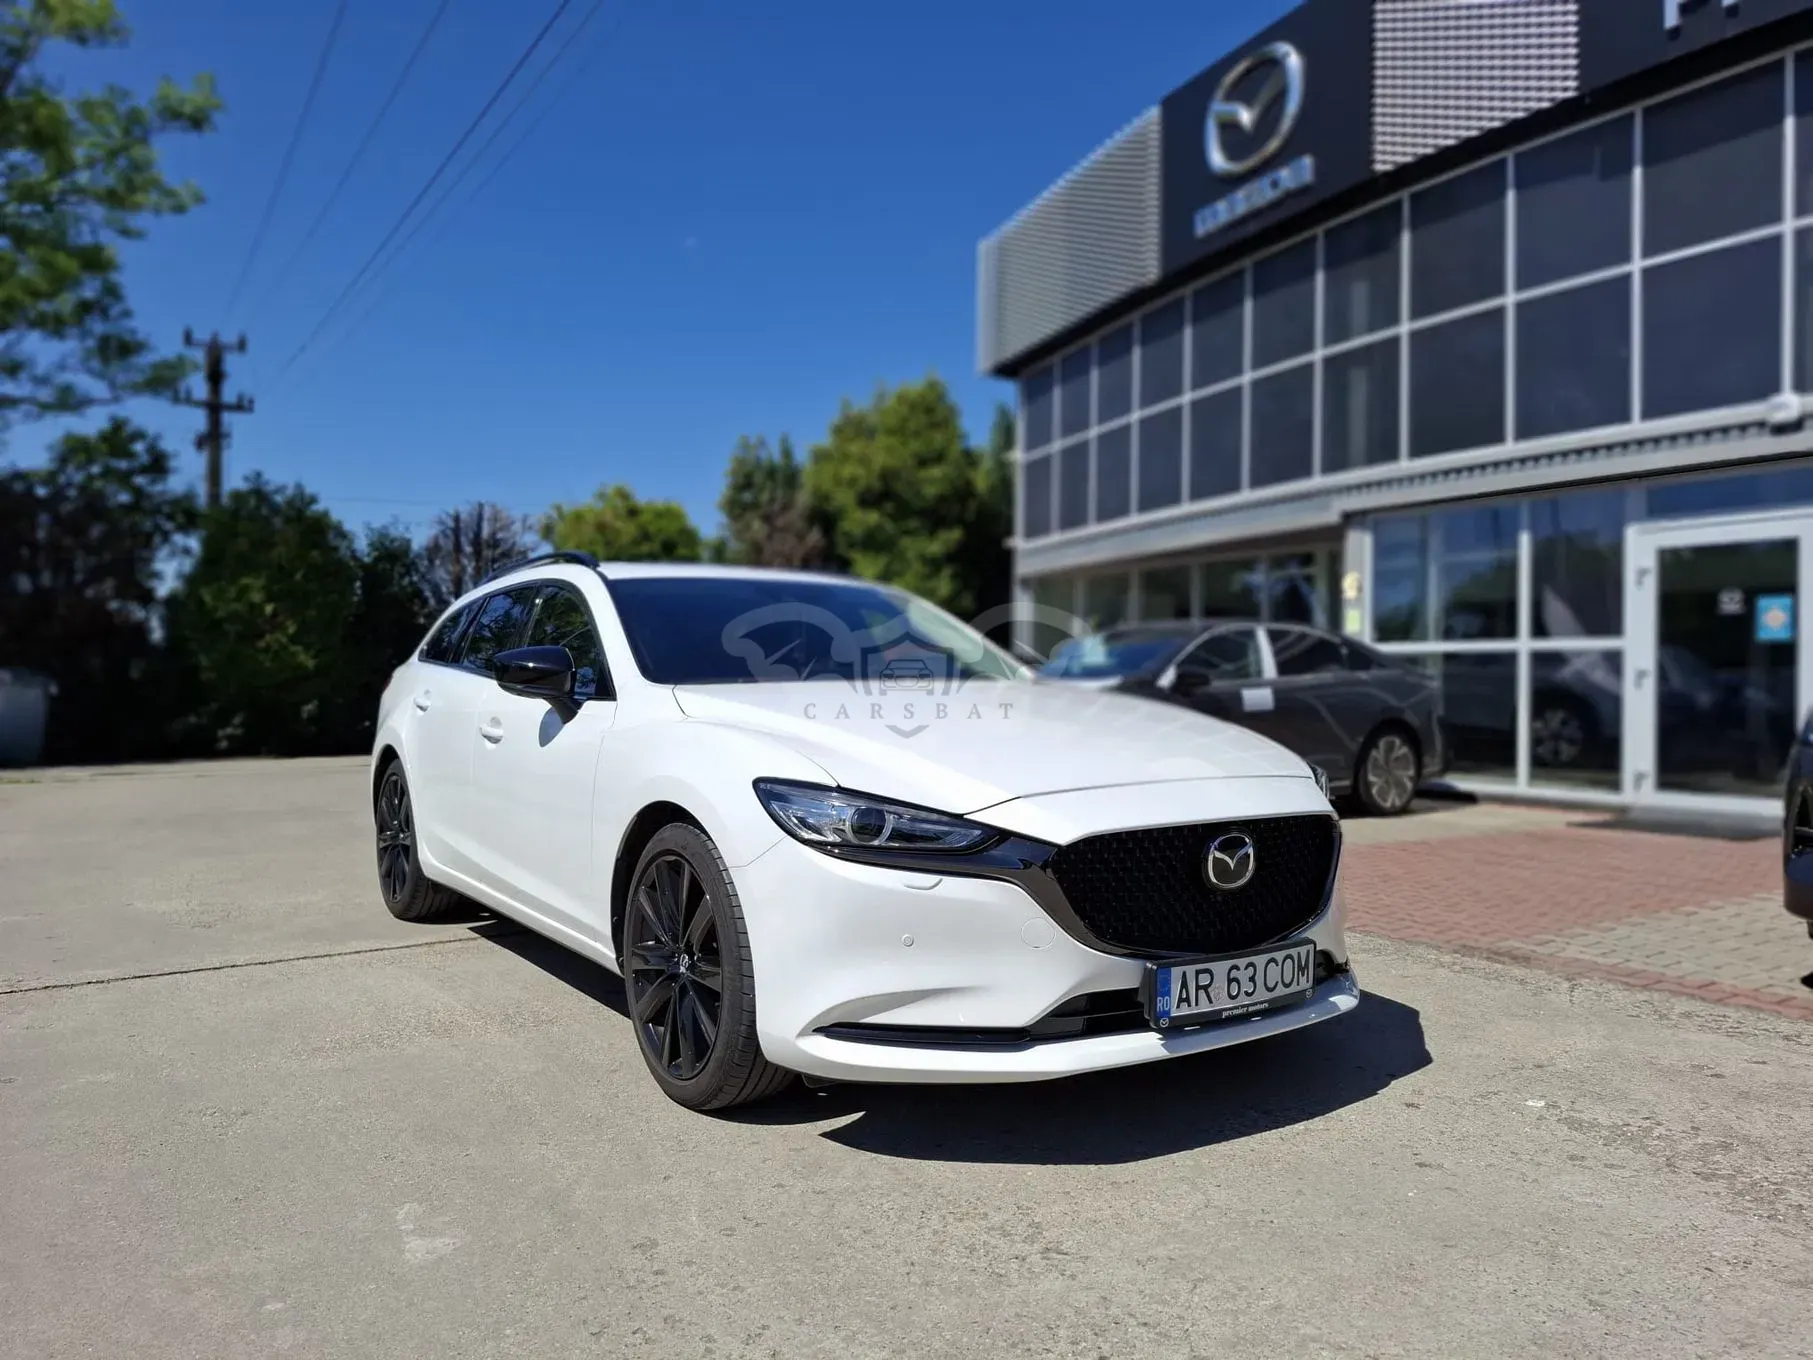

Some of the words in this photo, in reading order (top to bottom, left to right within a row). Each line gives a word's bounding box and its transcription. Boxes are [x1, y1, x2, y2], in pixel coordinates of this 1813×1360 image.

[1176, 967, 1215, 1010] AR
[1226, 962, 1258, 1001] 63
[1263, 949, 1311, 993] COM
[1156, 996, 1170, 1011] RO
[1222, 1006, 1248, 1018] premier
